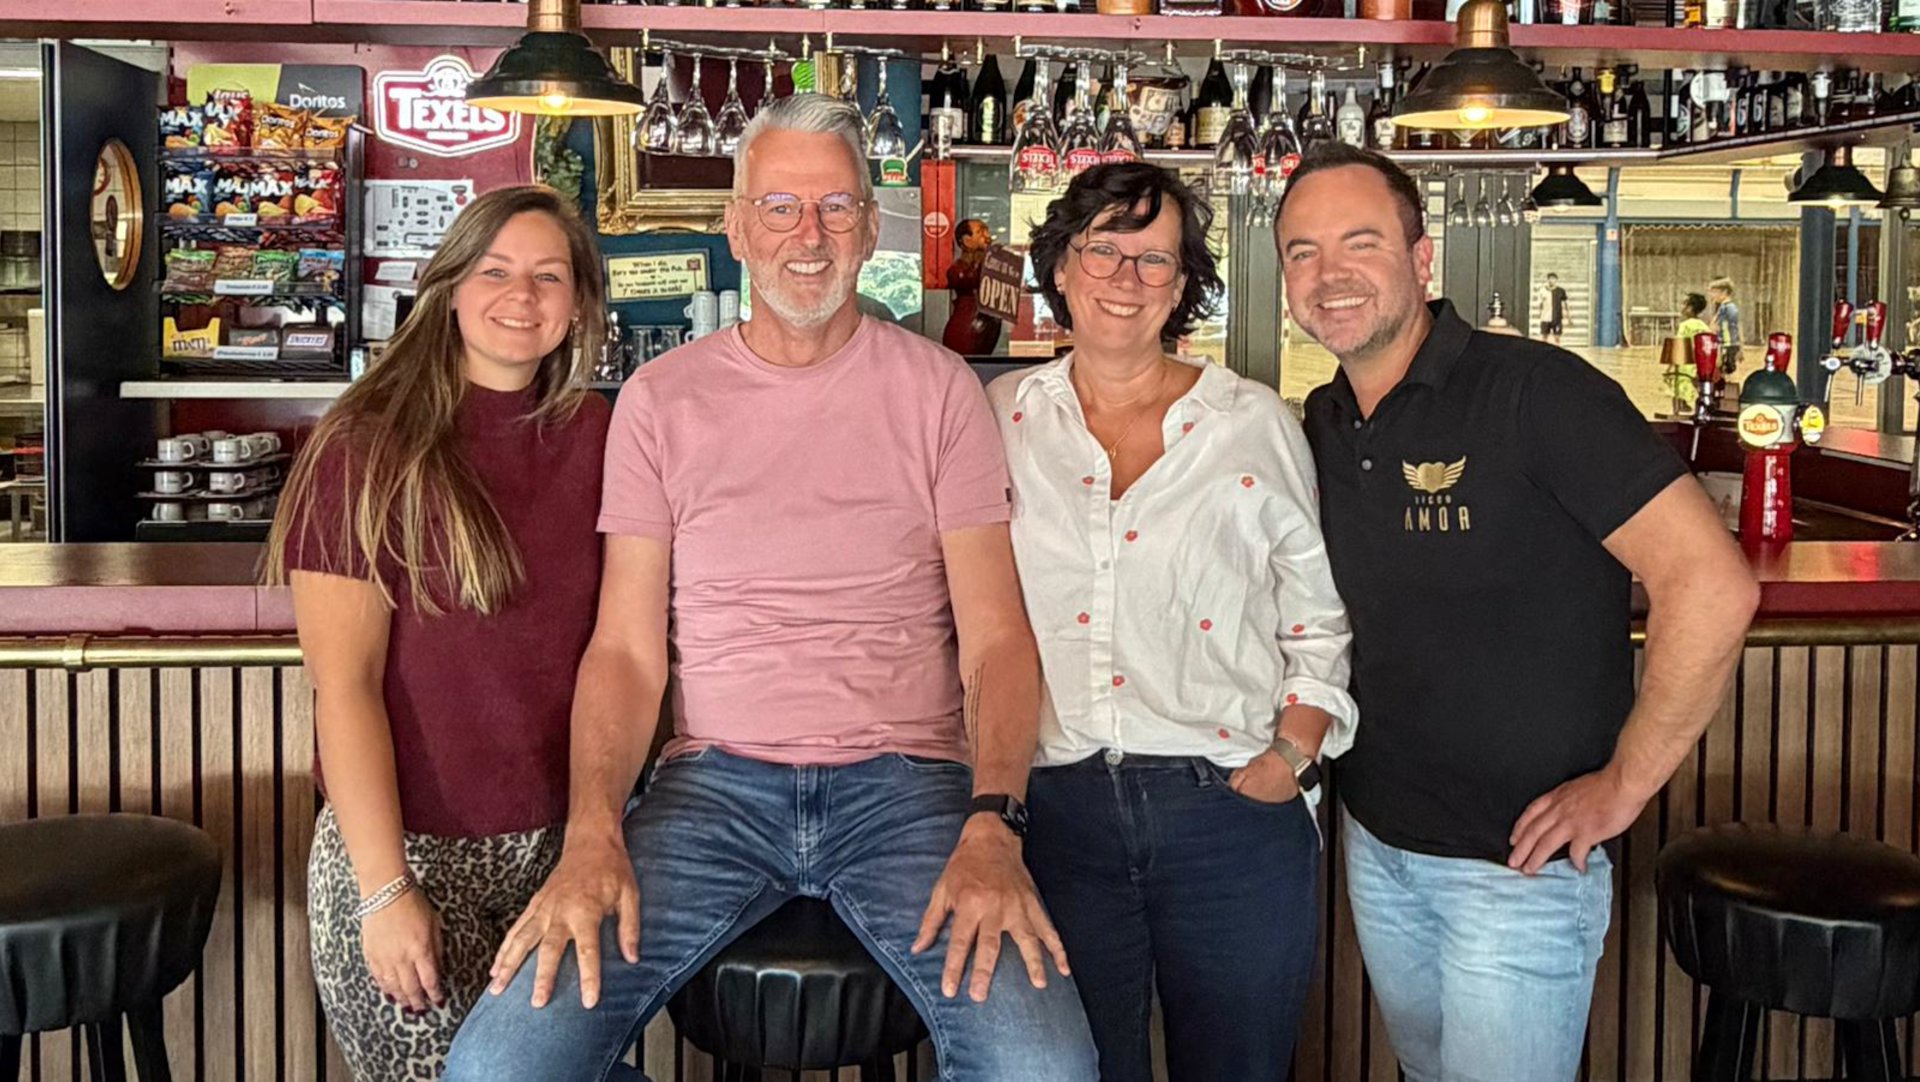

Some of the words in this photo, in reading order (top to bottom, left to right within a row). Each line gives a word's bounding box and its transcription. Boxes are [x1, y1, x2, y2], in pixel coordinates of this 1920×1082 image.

[289, 94, 347, 109] Doritos
[388, 87, 507, 131] TEXELS
[159, 110, 204, 127] MAX
[164, 175, 209, 194] MAX
[250, 180, 294, 197] MAX
[979, 275, 1020, 317] OPEN
